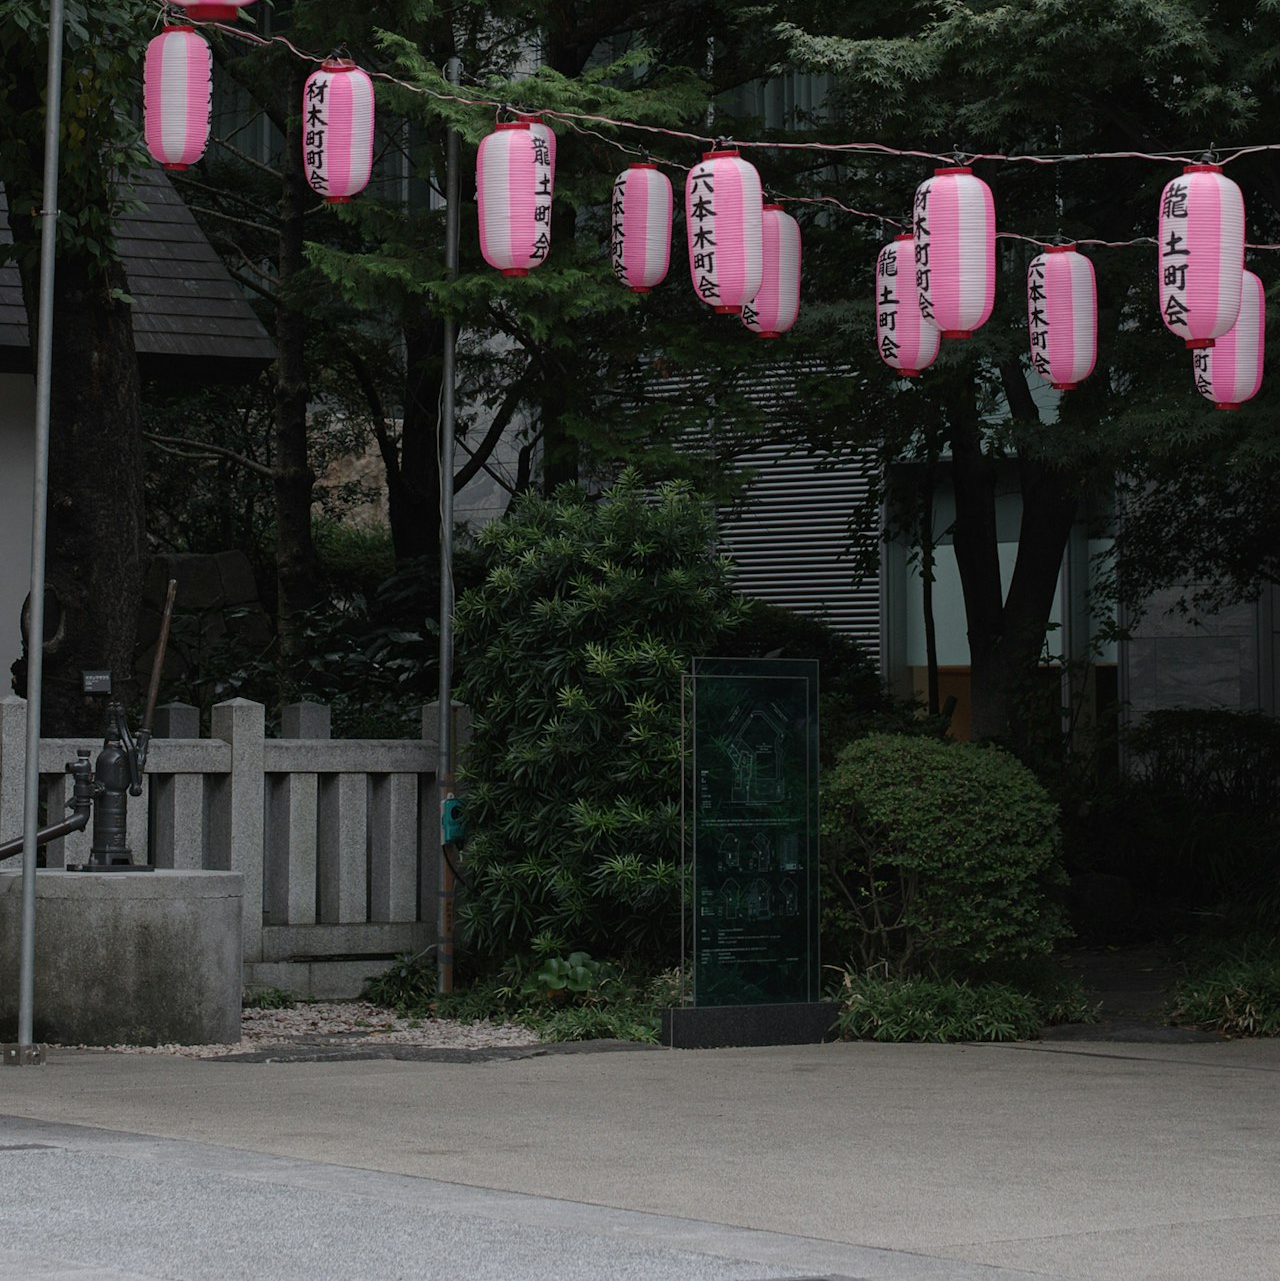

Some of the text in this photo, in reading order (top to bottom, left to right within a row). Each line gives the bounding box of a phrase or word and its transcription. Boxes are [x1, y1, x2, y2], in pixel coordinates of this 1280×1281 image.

[305, 79, 329, 191] 材木町町会
[612, 176, 628, 280] 六本木町会
[691, 167, 721, 298] 六本木町会
[1162, 183, 1191, 326] 龍土町会
[878, 248, 900, 360] 龍土町会
[1029, 257, 1051, 376] 六本木町会
[1194, 347, 1213, 396] 町会
